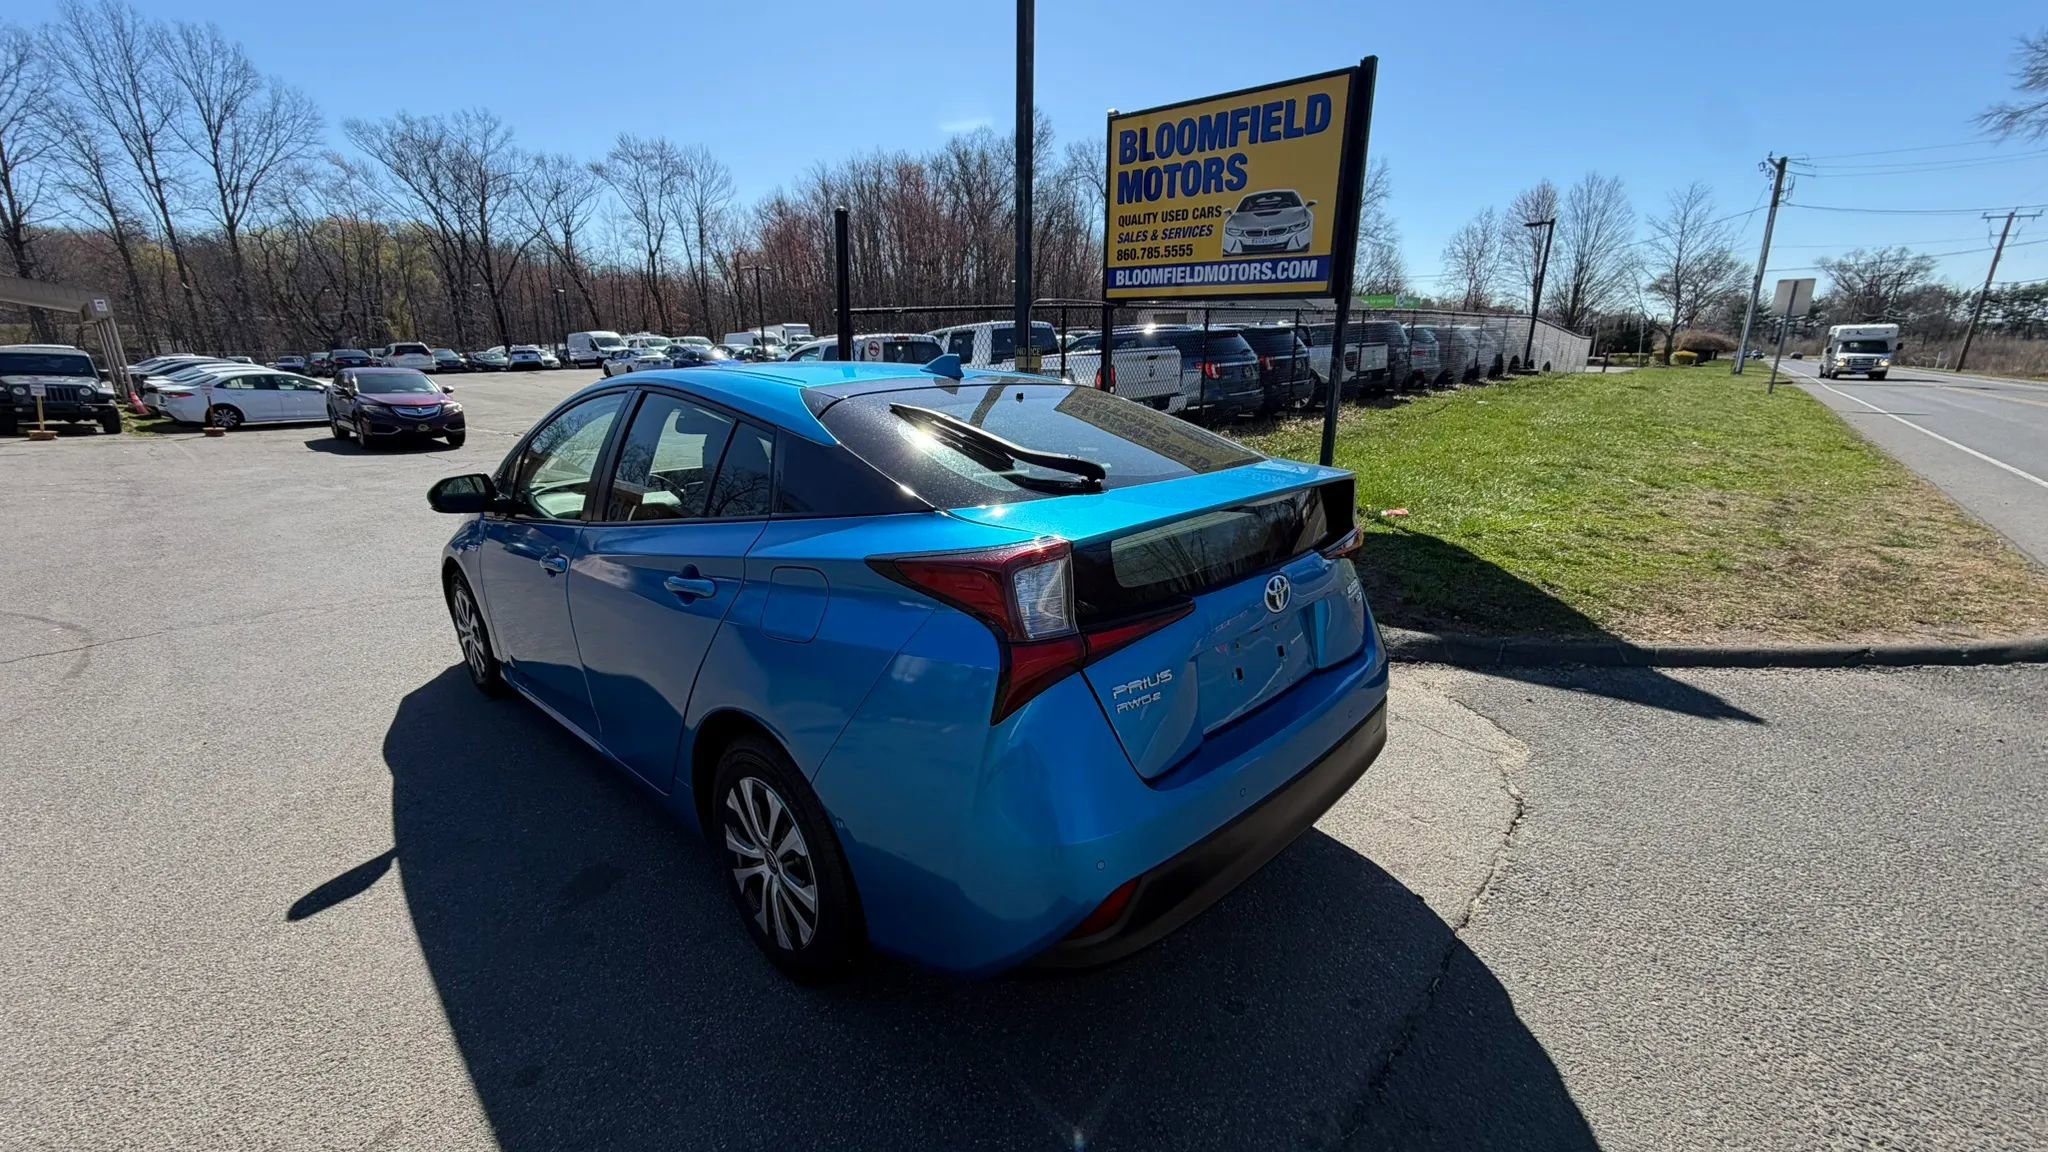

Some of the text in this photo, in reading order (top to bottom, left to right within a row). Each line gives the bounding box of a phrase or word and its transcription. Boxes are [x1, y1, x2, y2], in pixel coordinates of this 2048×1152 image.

[1119, 93, 1332, 165] BLOOMFIELD
[1117, 153, 1248, 205] MOTORS
[1118, 205, 1222, 228] QUALITY USED CARS
[1117, 224, 1214, 244] SALES & SERVICES
[1116, 244, 1193, 262] 860.785.5555
[1115, 259, 1318, 286] BLOOMFIELDMOTORS.COM
[1016, 346, 1041, 356] NOCE
[1112, 669, 1173, 700] PRIUS
